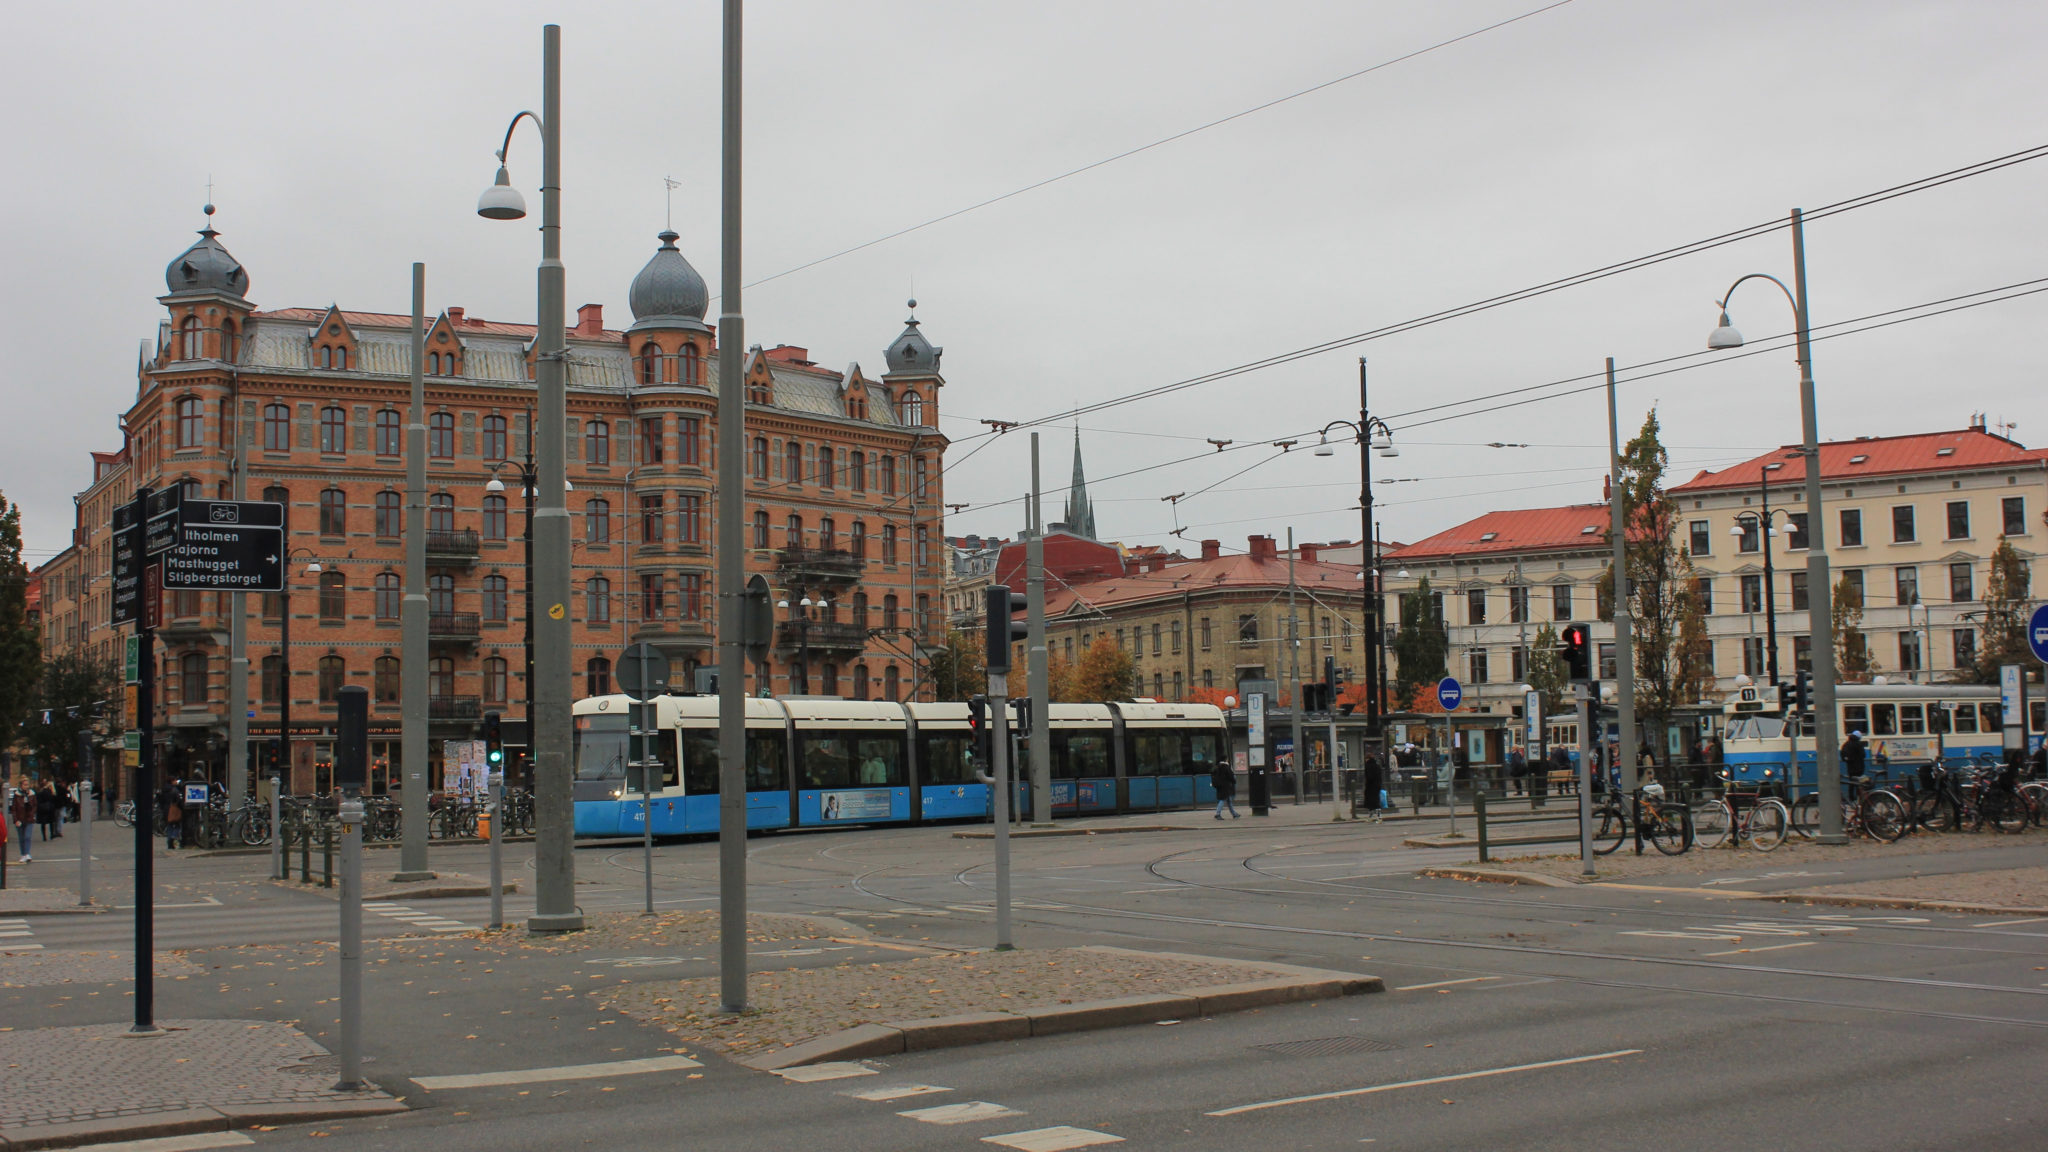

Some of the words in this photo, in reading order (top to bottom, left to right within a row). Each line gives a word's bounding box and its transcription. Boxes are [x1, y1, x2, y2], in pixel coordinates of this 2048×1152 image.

[185, 530, 239, 541] ltholmen
[168, 544, 219, 556] ajorna
[168, 558, 240, 572] Masthugget
[168, 572, 262, 585] Stigbergstorget
[1743, 689, 1754, 698] 11
[634, 812, 646, 821] 417
